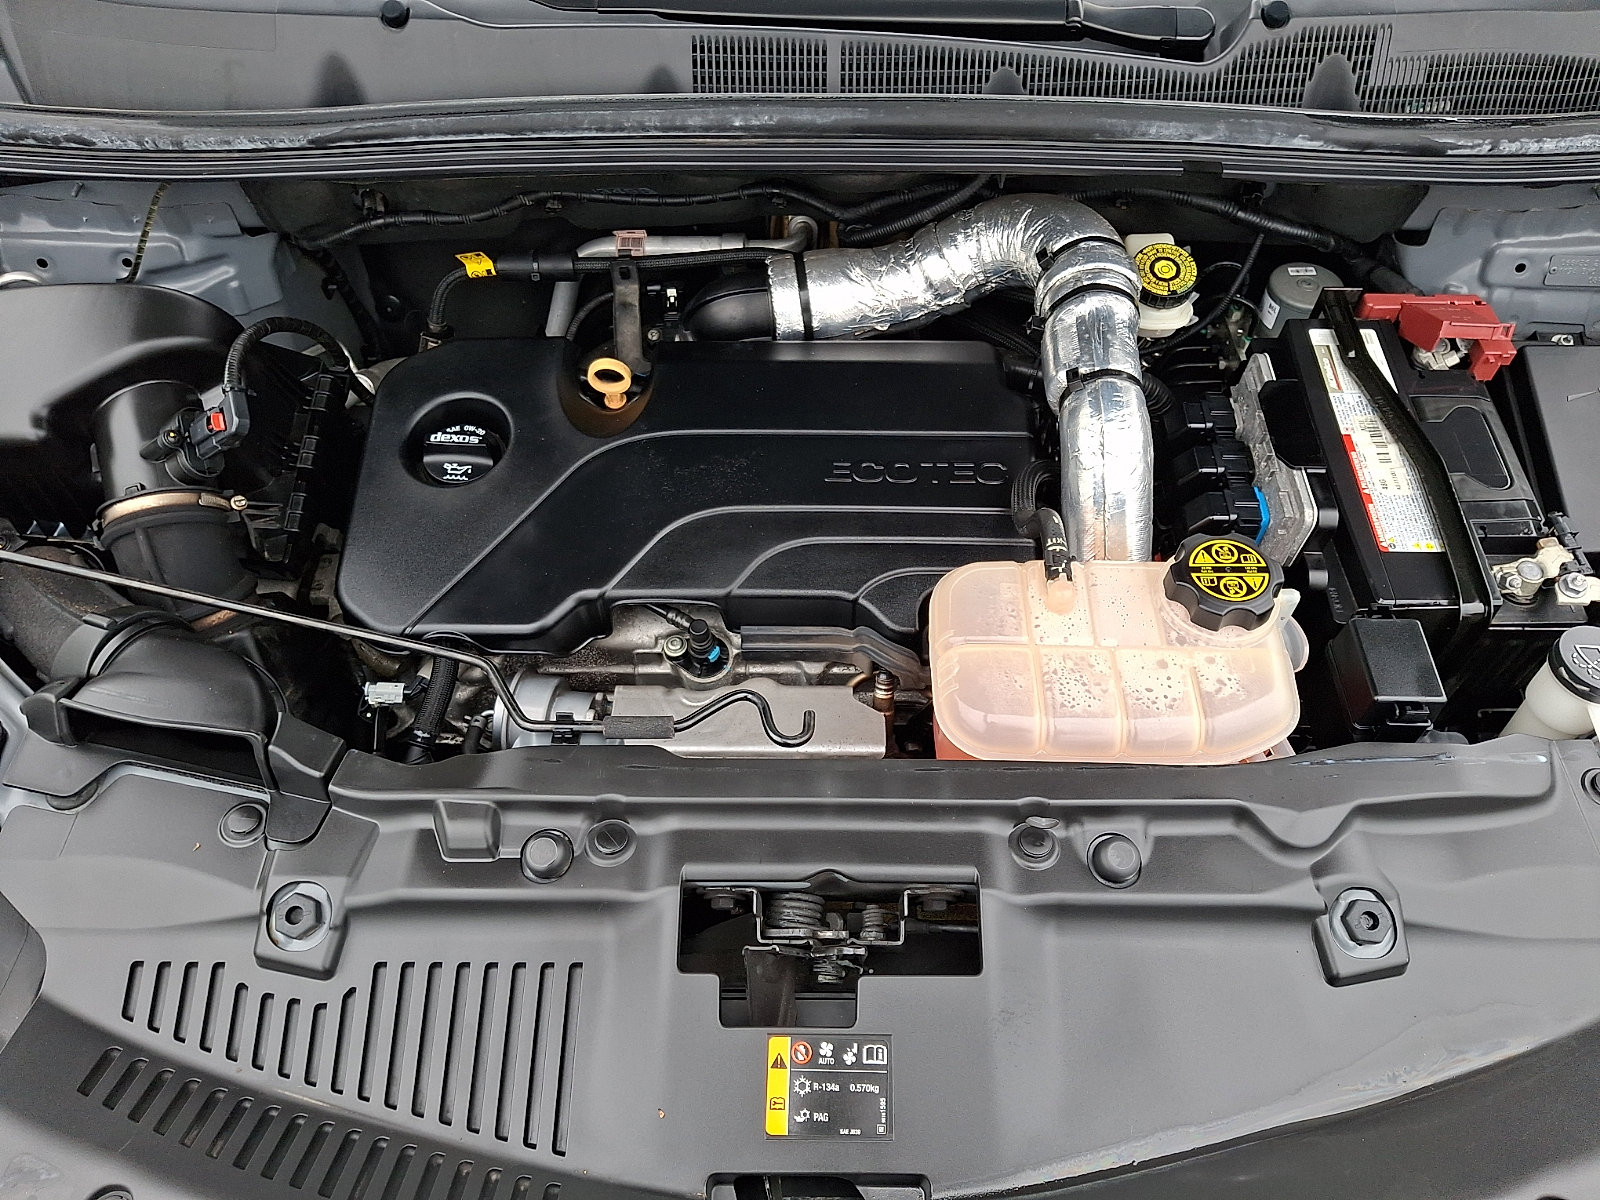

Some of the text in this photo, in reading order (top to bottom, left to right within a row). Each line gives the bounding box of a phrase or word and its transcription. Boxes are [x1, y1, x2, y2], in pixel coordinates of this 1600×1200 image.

[430, 432, 479, 443] dexos
[824, 462, 1008, 484] ECOTEC
[813, 1083, 880, 1093] R-134a 0.570kg
[813, 1112, 829, 1122] PAG
